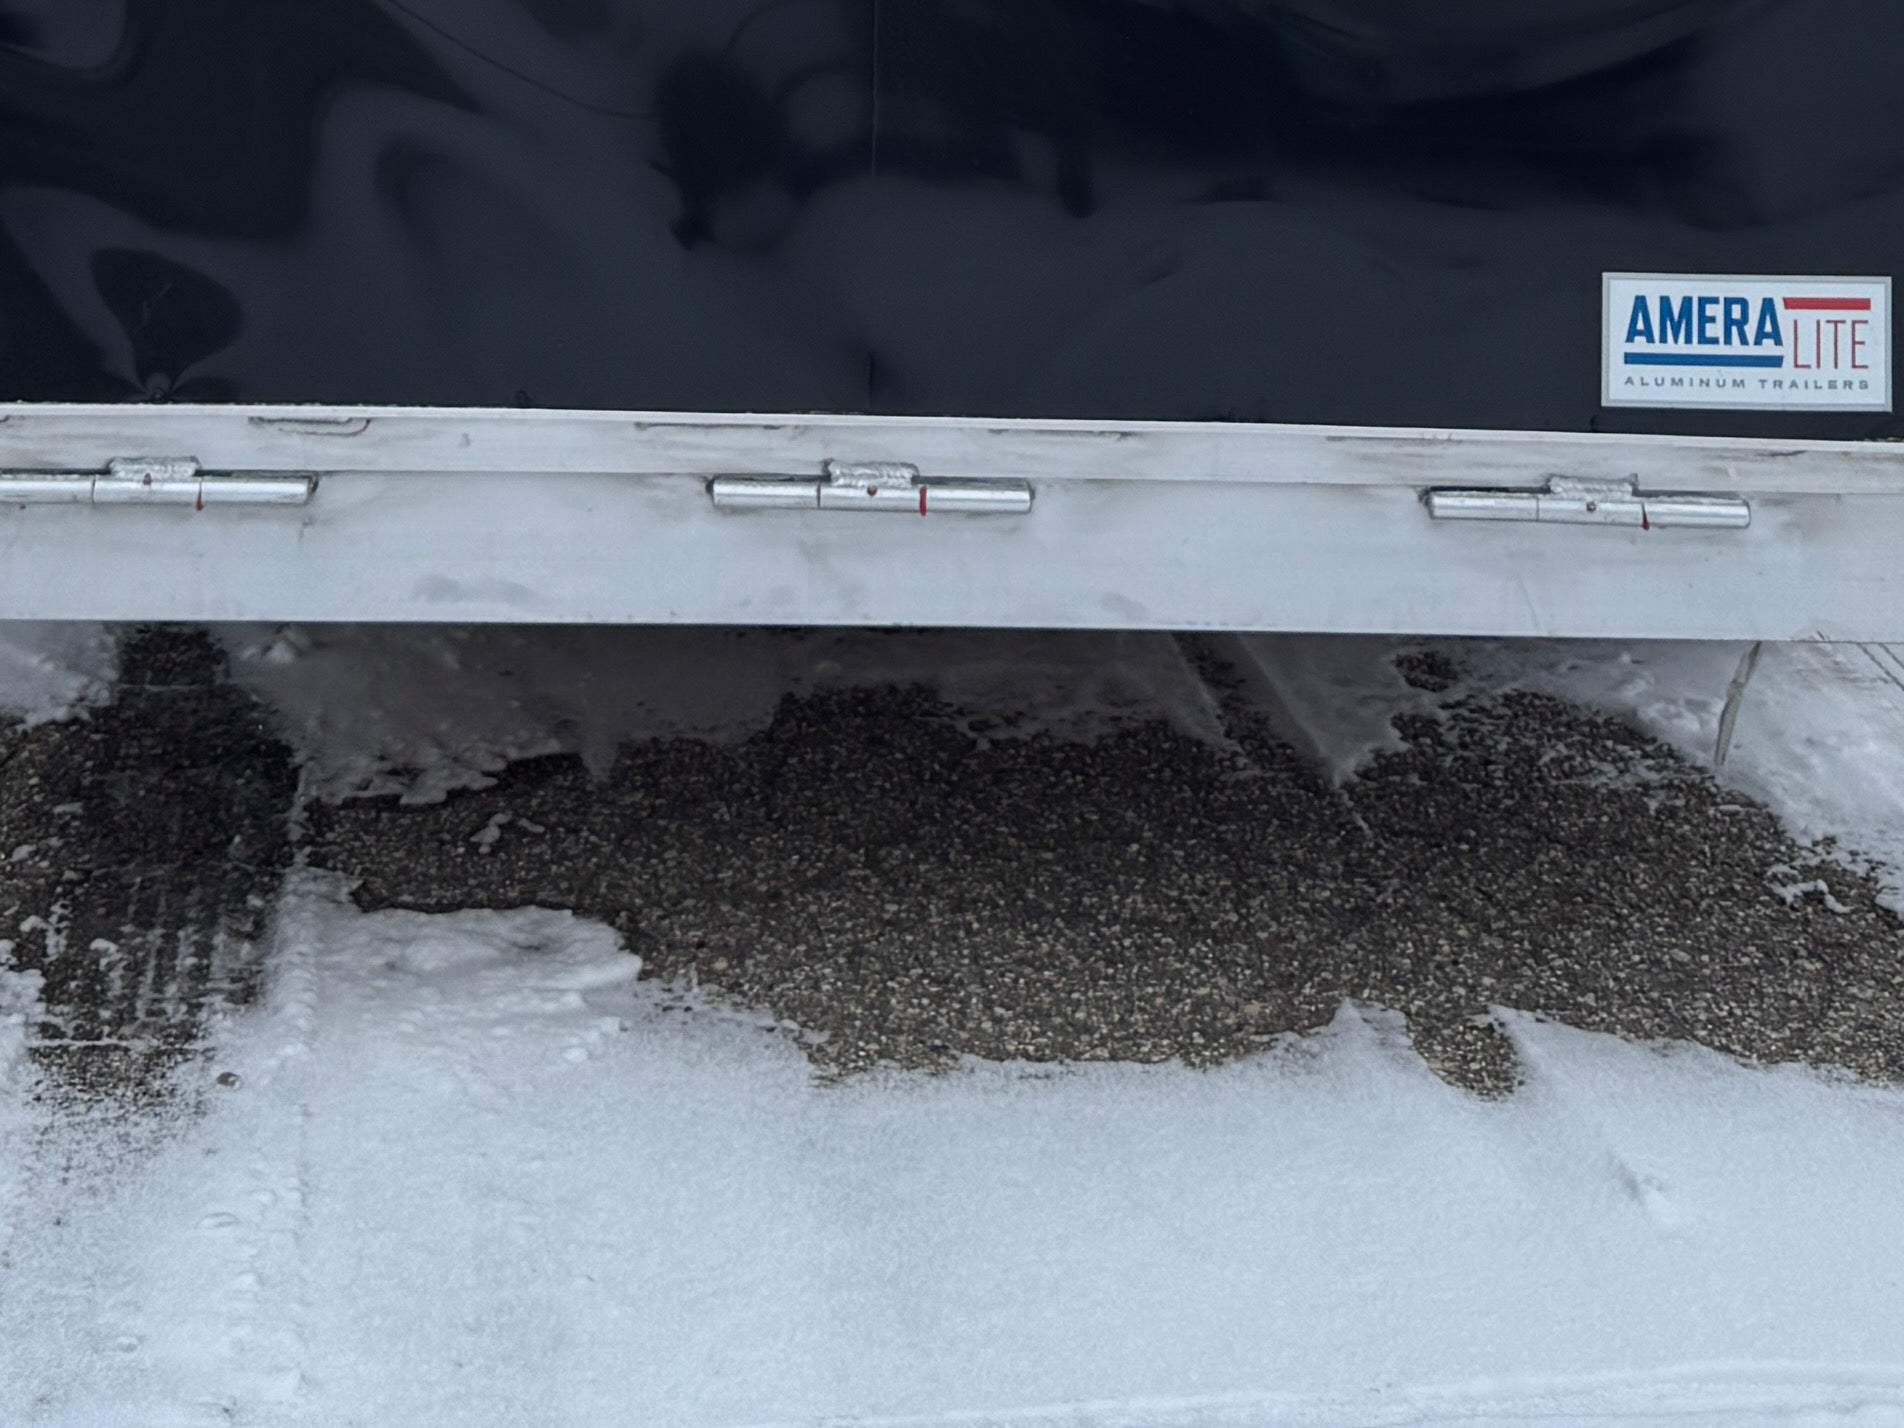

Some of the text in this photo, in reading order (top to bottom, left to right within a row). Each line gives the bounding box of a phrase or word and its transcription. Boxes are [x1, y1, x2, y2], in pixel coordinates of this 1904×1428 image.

[1624, 294, 1870, 370] AMERA LITE
[1624, 375, 1870, 391] ALUMINUM TRAILERS
